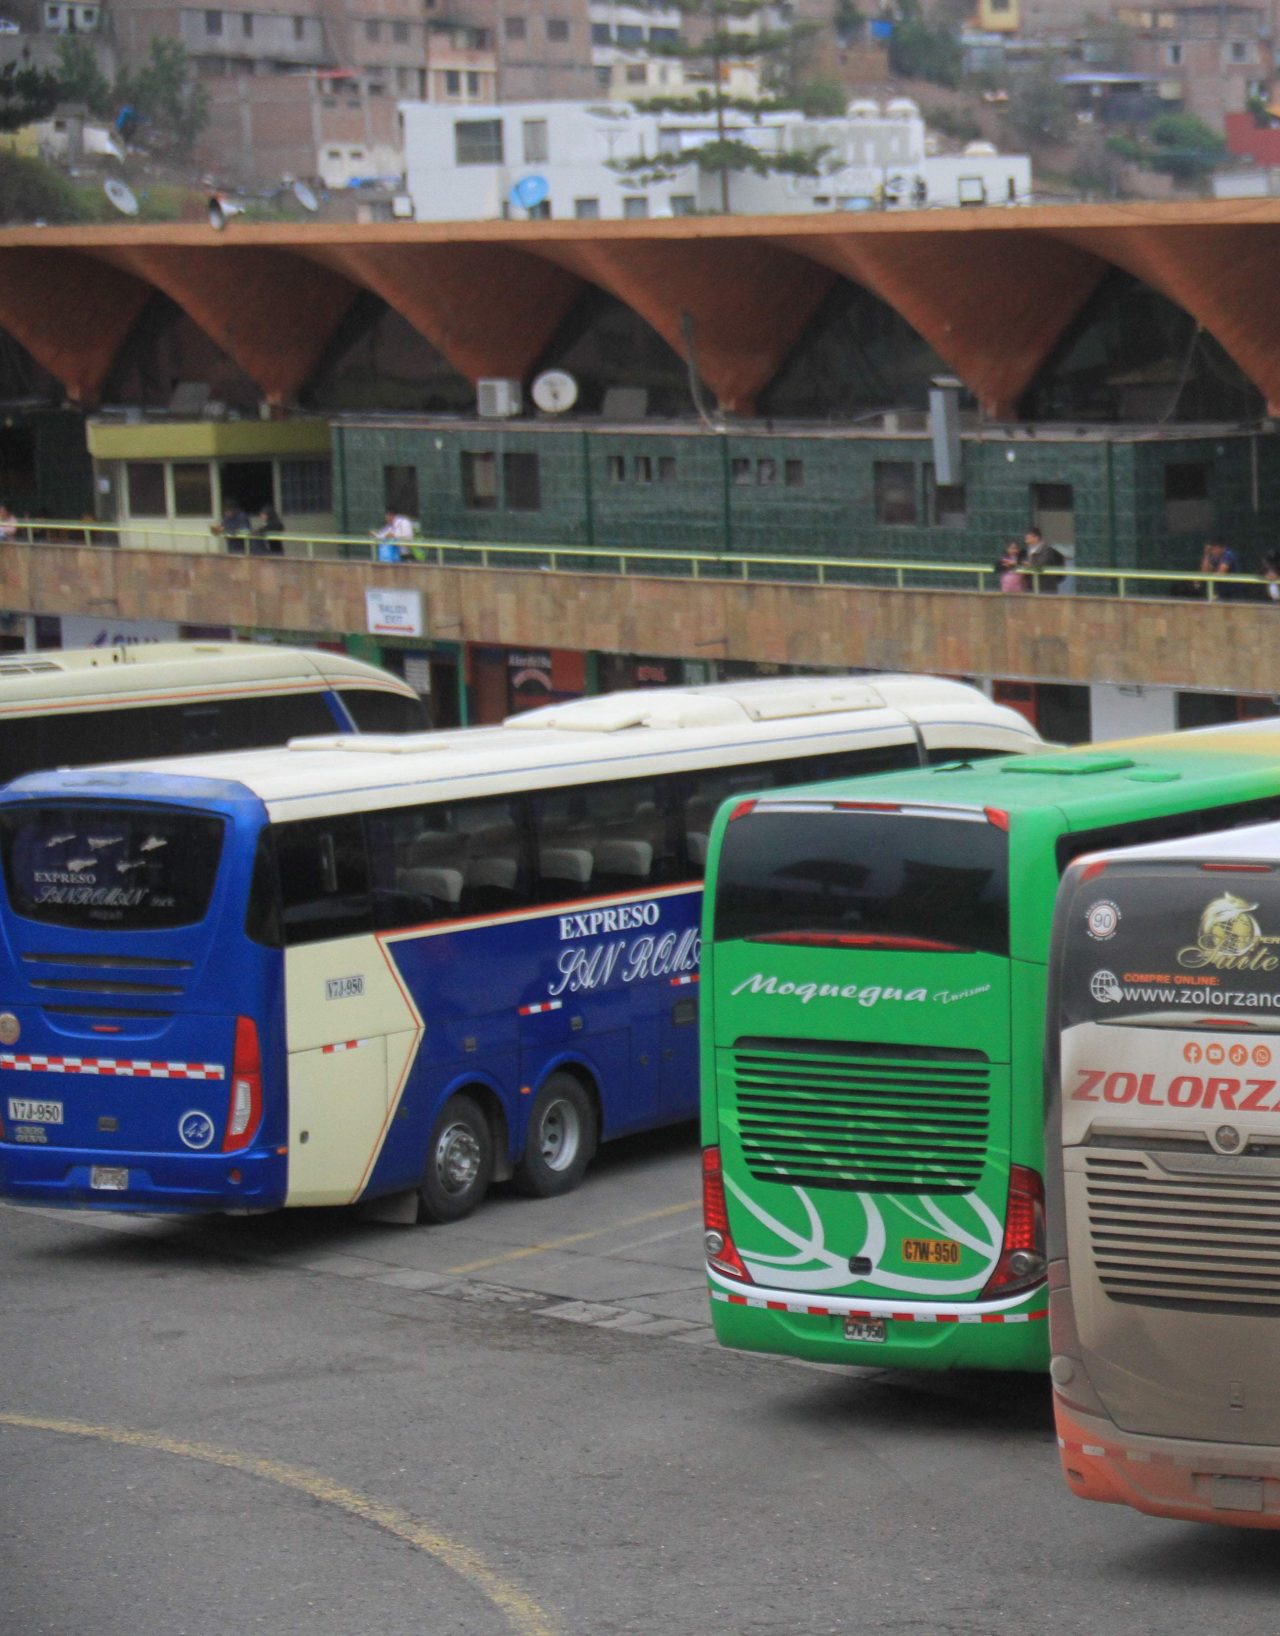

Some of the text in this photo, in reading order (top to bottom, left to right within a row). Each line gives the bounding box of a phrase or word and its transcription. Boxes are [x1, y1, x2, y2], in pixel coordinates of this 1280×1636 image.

[34, 872, 96, 884] EXPRESO
[559, 903, 660, 940] EXPRESO
[1094, 913, 1112, 928] 90
[1177, 935, 1280, 972] Suite
[548, 941, 625, 996] SAN
[1123, 973, 1170, 984] COMPRE
[327, 978, 363, 999] V7J-950
[731, 973, 991, 1007] Moquegua Turismo
[12, 1102, 60, 1122] V7J-950
[184, 1122, 210, 1139] 42
[904, 1240, 958, 1263] C7W-950
[846, 1324, 884, 1340] C7W-950
